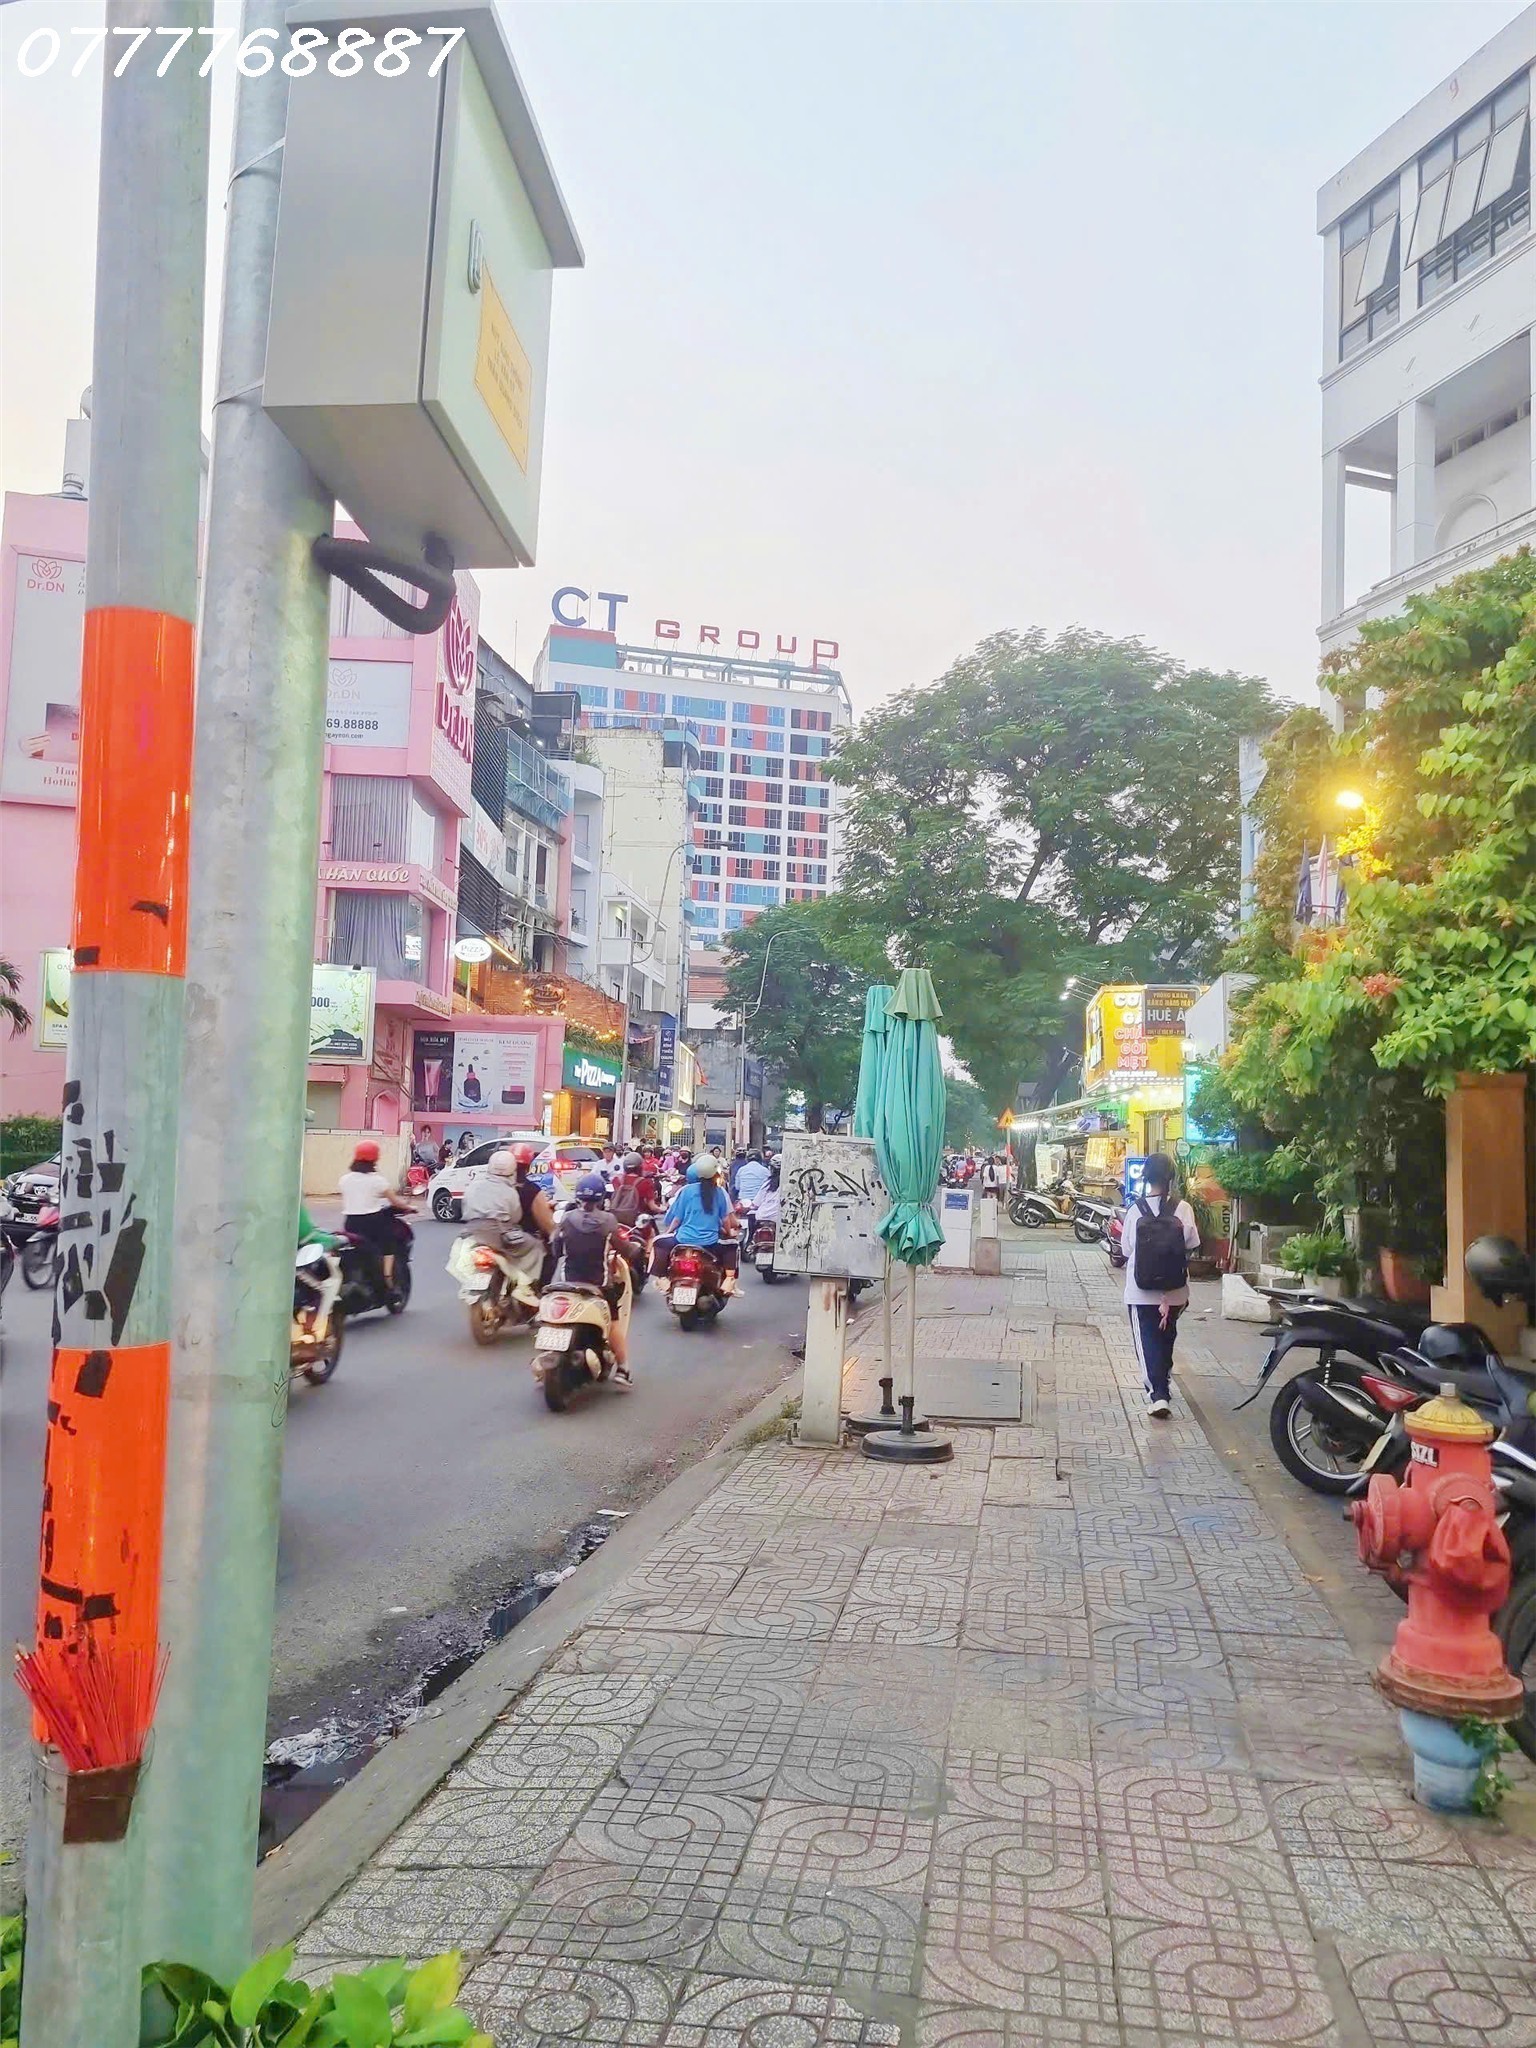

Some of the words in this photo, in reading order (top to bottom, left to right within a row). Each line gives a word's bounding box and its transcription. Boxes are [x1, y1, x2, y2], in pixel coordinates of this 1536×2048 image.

[27, 578, 65, 593] Dr.DN
[551, 586, 628, 627] CT
[655, 619, 839, 674] GROUP
[434, 682, 474, 764] Dr.DN
[1147, 1007, 1172, 1024] HUỆ
[1117, 1056, 1149, 1070] MẸT
